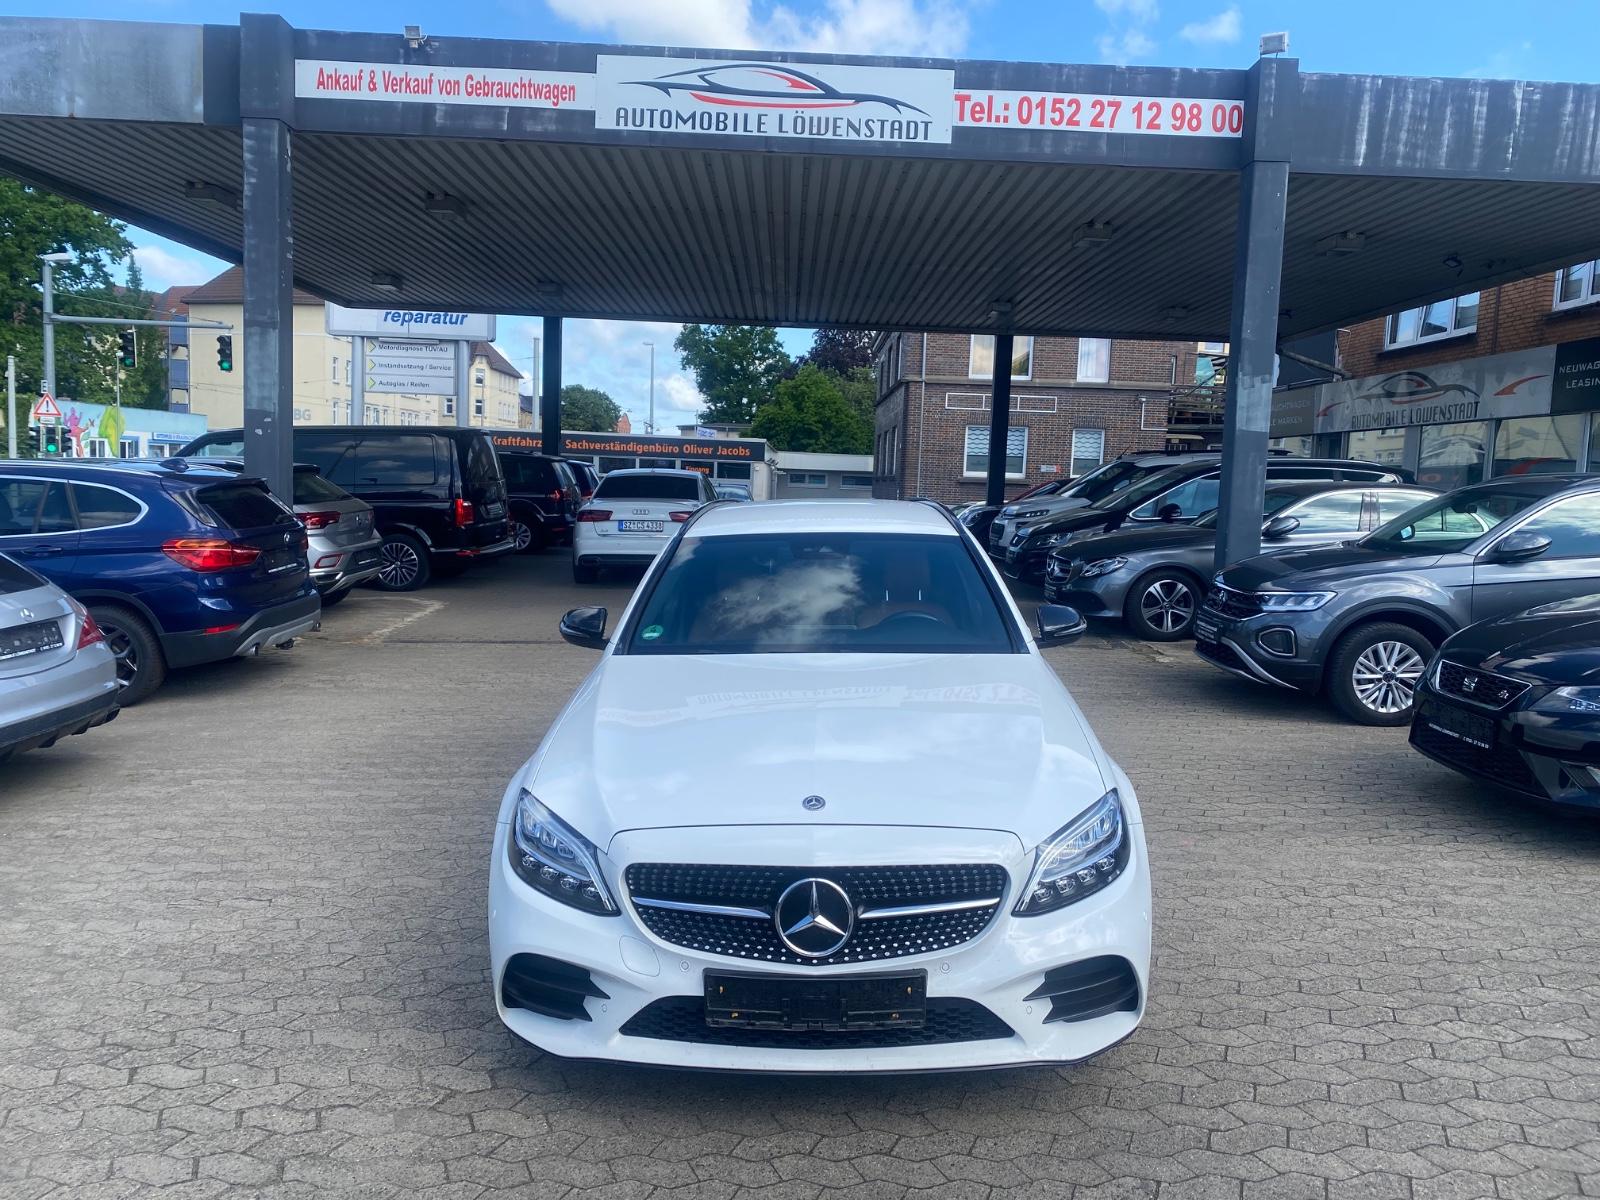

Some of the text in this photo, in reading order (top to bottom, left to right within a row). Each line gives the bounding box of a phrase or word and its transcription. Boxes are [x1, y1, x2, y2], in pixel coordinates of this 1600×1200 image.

[316, 67, 576, 107] Ankauf & Verkauf von Gebrauchtwagen
[615, 107, 933, 141] AUTOMOBILE LÖWENSTADT
[954, 93, 1243, 134] Tel.: 0152 27 12 98 00
[383, 311, 468, 326] reparatur
[1351, 409, 1407, 430] AUTOMOBILE
[493, 436, 752, 456] Kraftfahrz Sachverständigenbüro Oliver Jacobs
